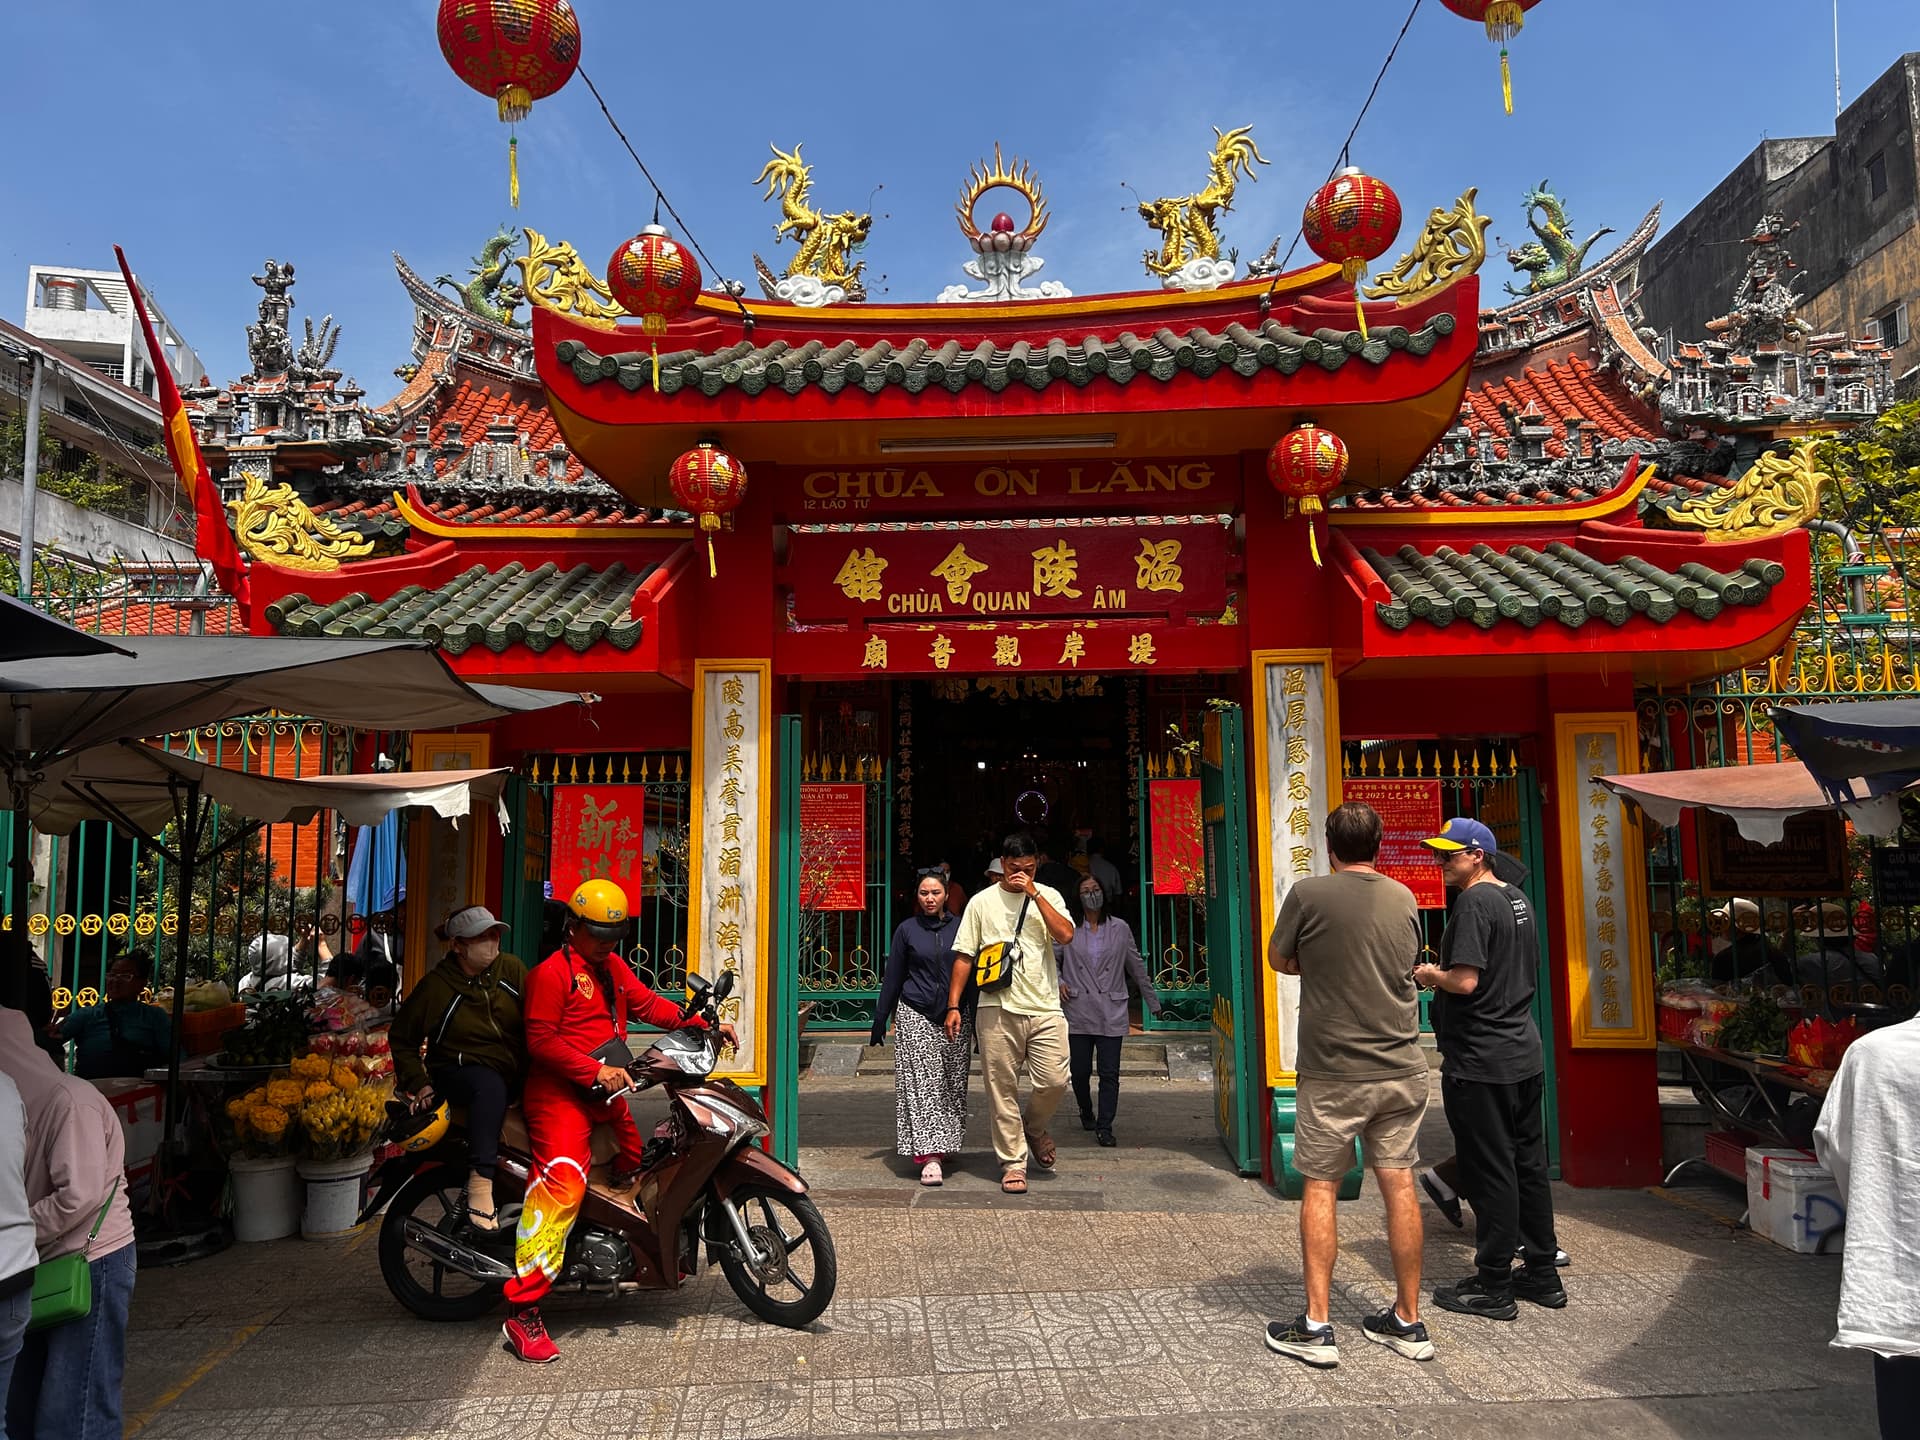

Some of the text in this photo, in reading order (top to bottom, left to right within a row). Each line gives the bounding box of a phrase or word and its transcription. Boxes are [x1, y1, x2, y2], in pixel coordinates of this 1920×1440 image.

[1067, 460, 1215, 494] LĂNG
[887, 585, 1126, 614] CHÙA QUAN ÂM
[607, 906, 623, 919] be
